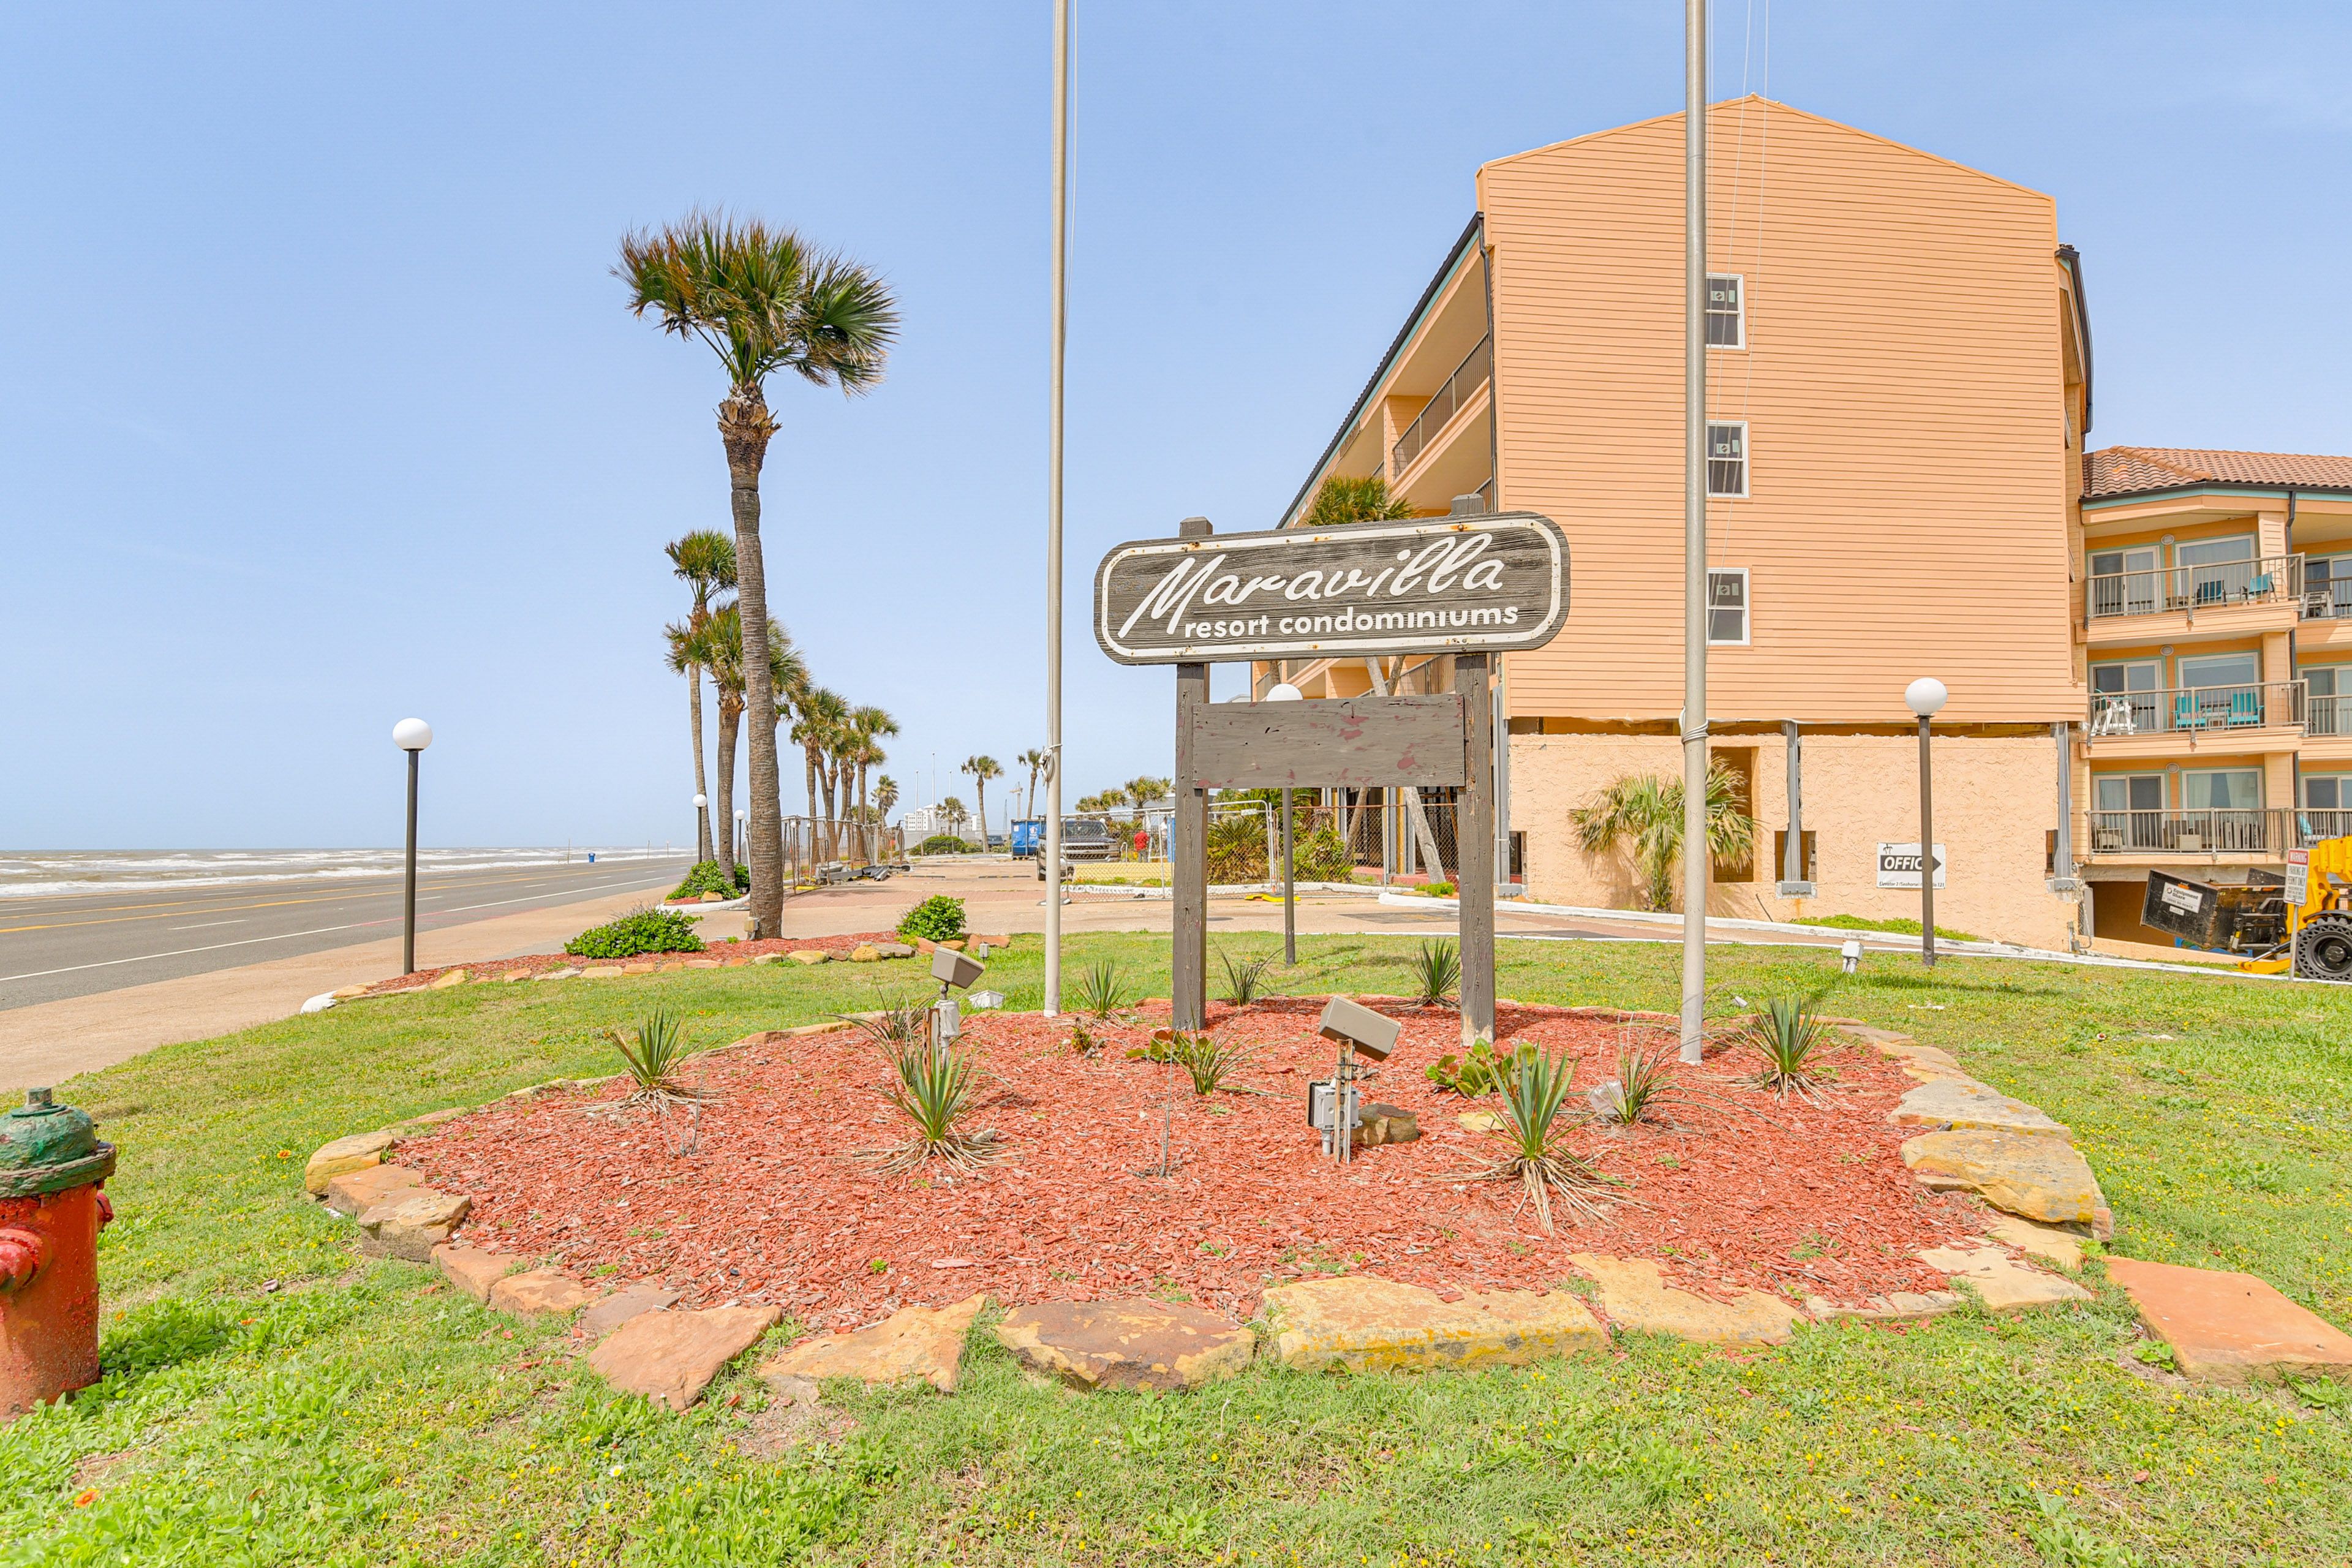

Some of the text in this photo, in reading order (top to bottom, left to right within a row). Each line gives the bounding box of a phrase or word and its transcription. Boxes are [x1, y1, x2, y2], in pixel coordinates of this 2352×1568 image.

[1118, 532, 1505, 638] Maravilla
[1185, 605, 1518, 638] resort condominiums
[1883, 856, 1923, 870] OFFIC
[2290, 852, 2307, 862] WARNING
[2289, 865, 2301, 875] PARKING
[2288, 876, 2297, 886] PERMIT
